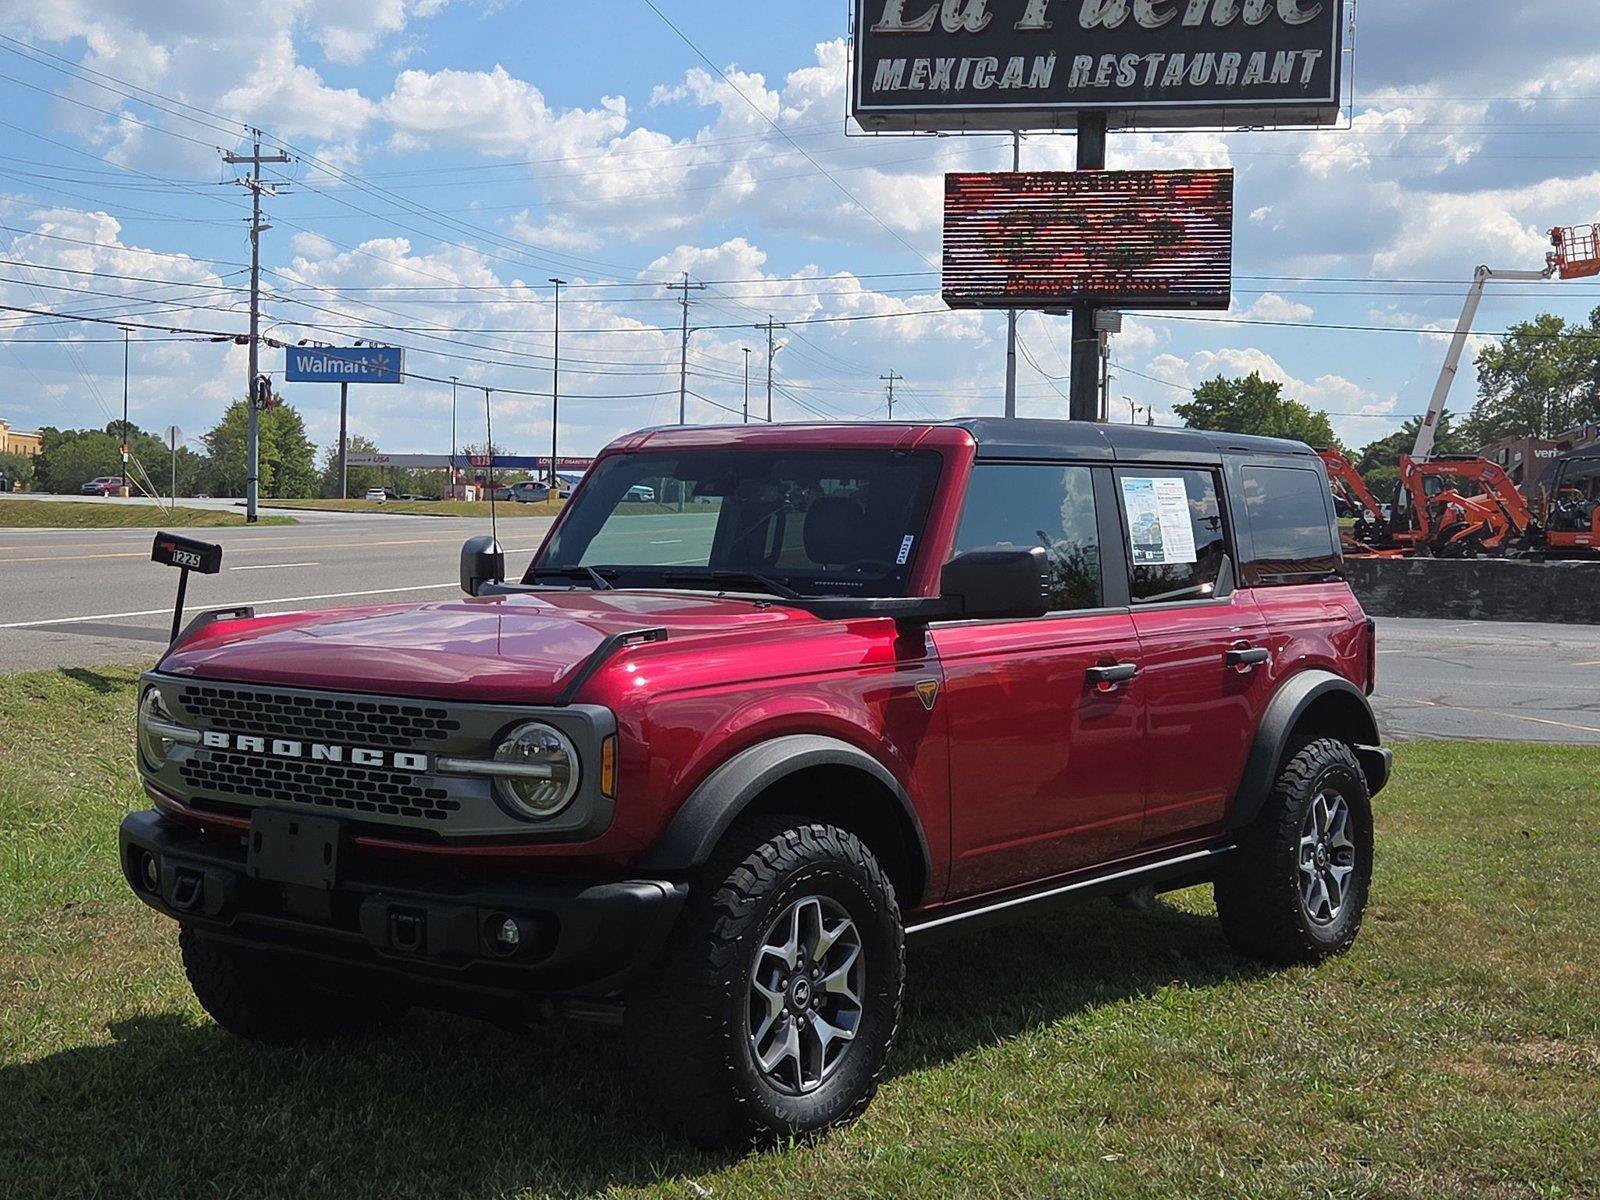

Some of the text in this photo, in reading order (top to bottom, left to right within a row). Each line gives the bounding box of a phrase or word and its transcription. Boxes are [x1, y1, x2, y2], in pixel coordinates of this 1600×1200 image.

[872, 49, 1322, 92] MEXICAN RESTAURANT
[296, 355, 369, 374] Walmart
[538, 457, 565, 465] LOWST
[174, 550, 199, 566] 1225
[203, 730, 428, 771] BRONCO
